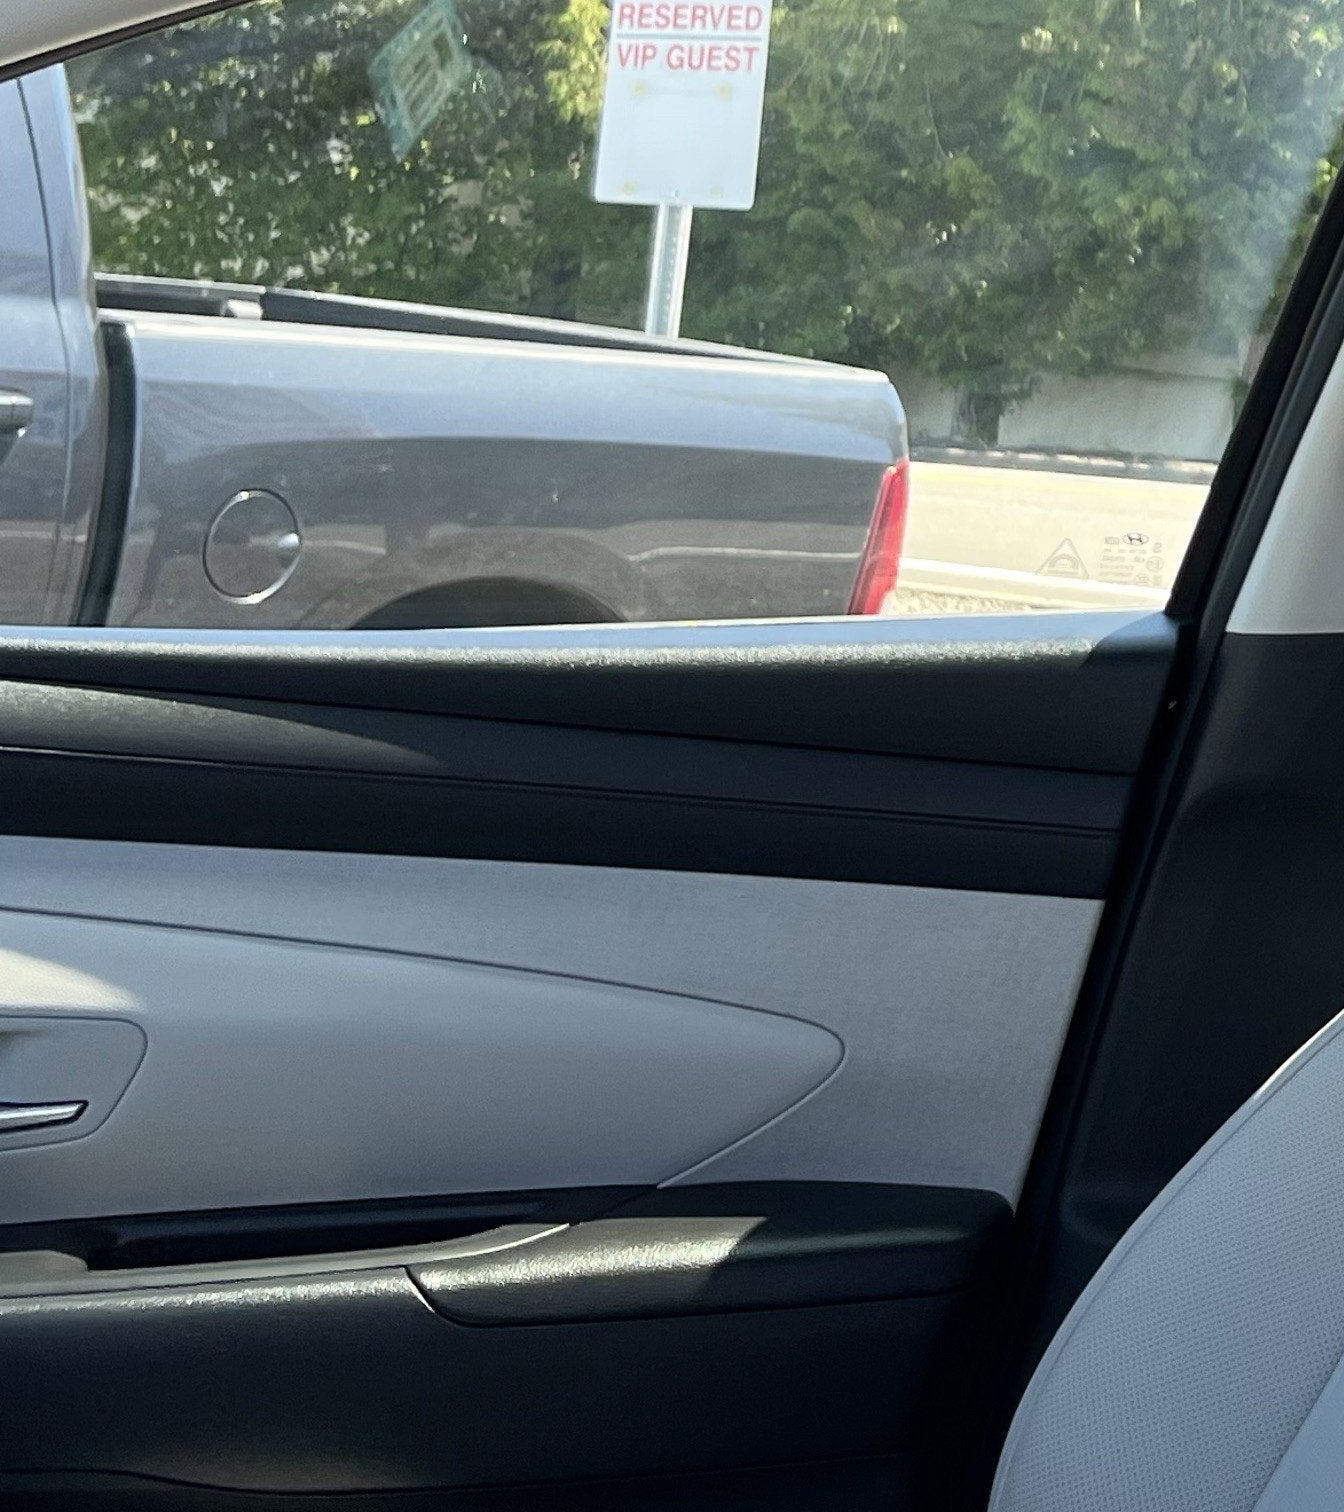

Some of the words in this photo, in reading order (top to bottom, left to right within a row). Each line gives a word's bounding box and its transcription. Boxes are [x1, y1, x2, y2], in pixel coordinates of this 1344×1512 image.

[619, 3, 762, 30] RESERVED
[617, 43, 657, 70] VIP
[667, 44, 759, 72] GUEST
